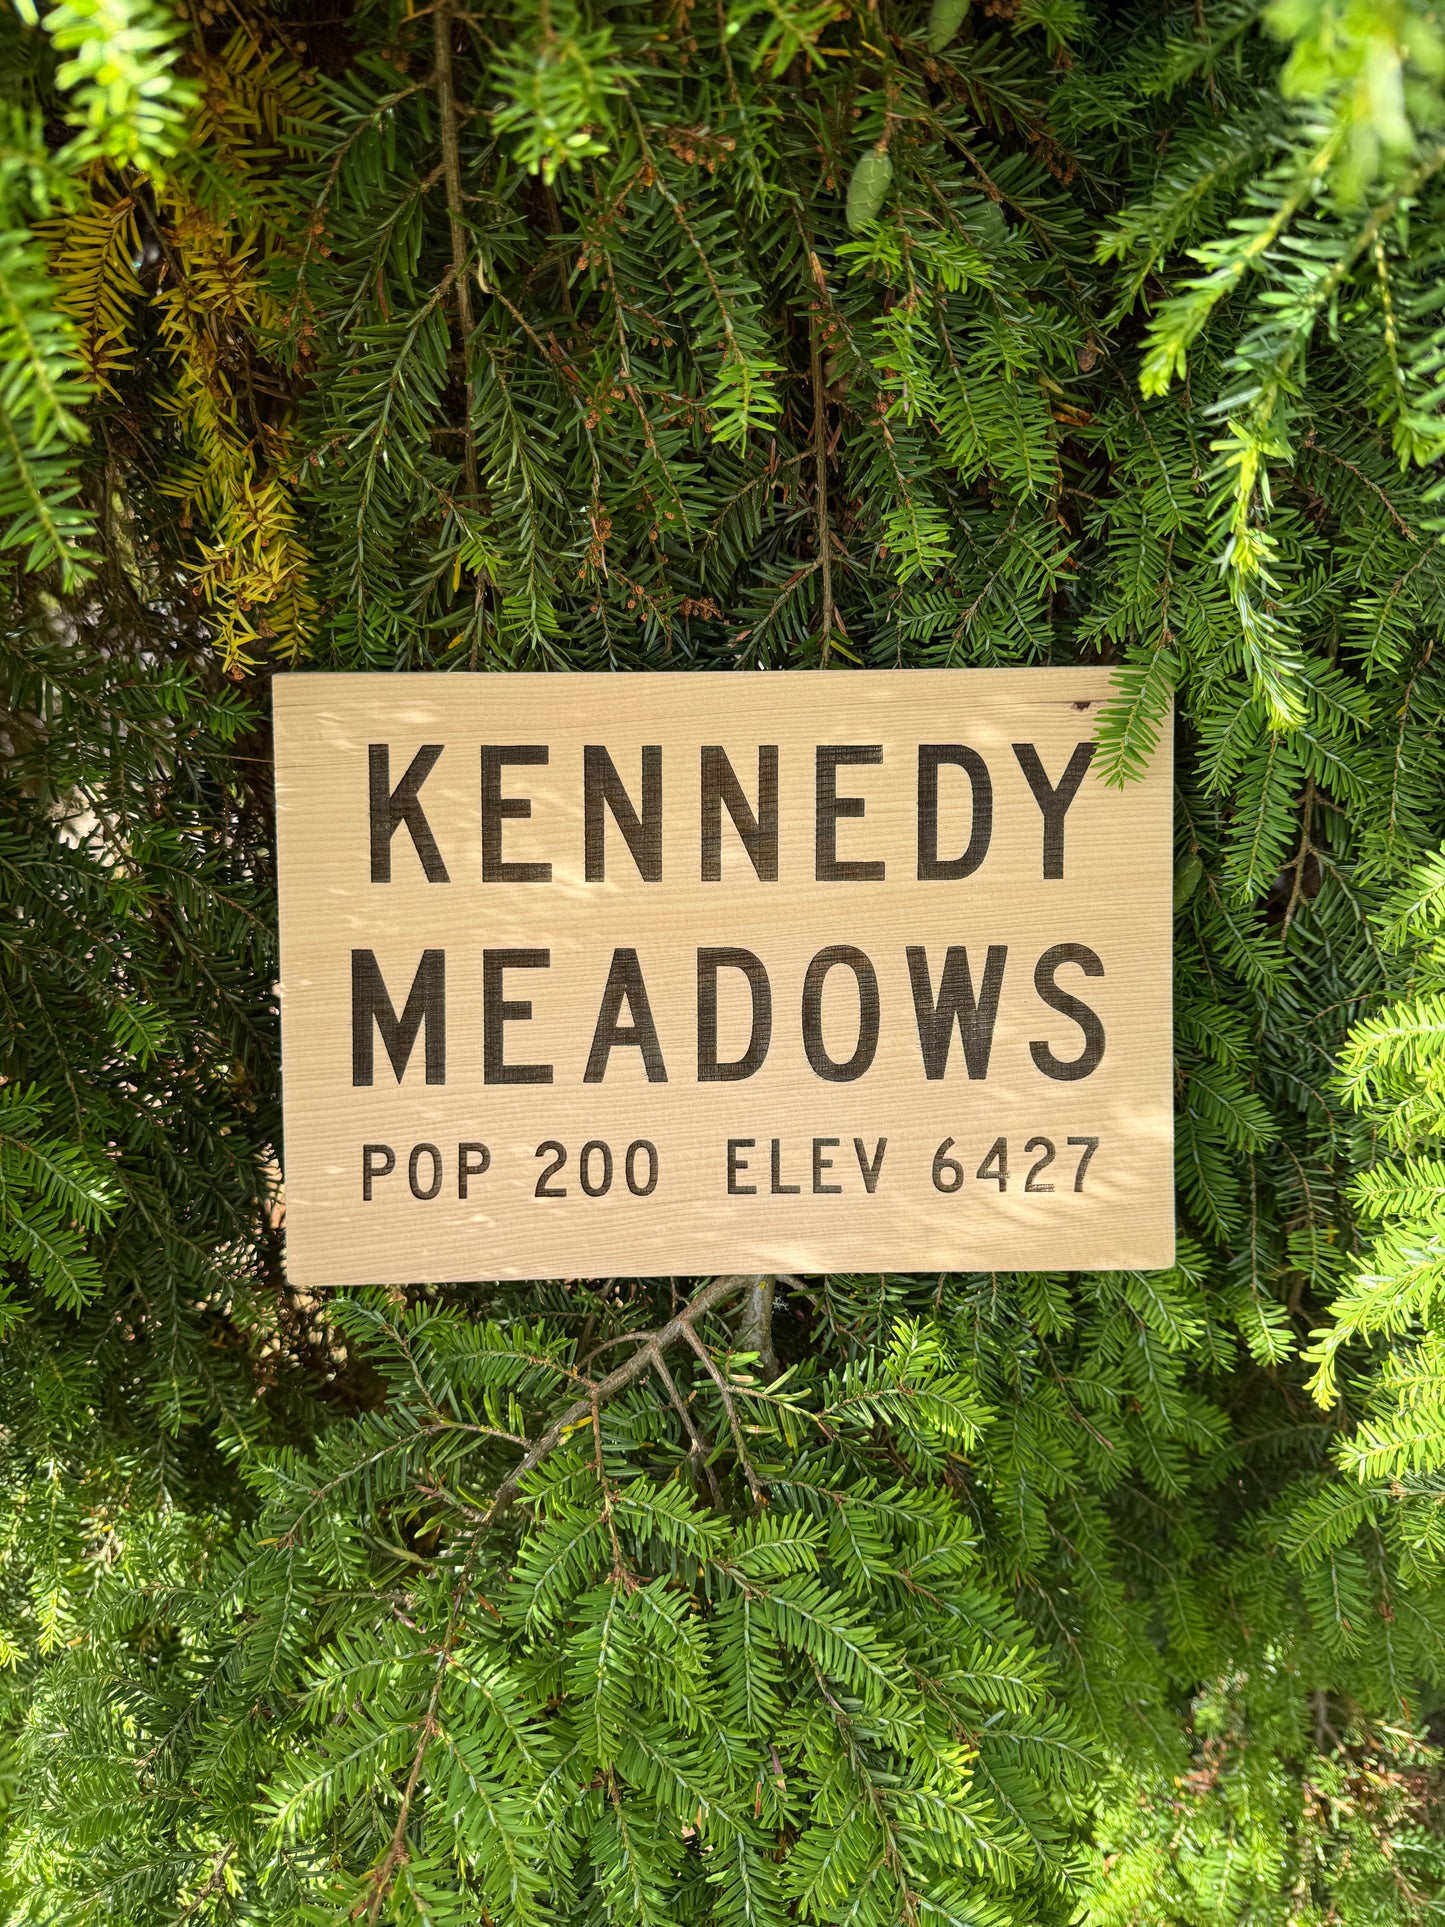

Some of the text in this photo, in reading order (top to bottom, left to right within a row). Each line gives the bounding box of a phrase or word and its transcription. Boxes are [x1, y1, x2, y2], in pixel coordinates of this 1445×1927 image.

[368, 742, 1099, 883] KENNEDY
[352, 943, 1105, 1086] MEADOWS
[363, 1137, 1098, 1201] POP 200 ELEV 6427
